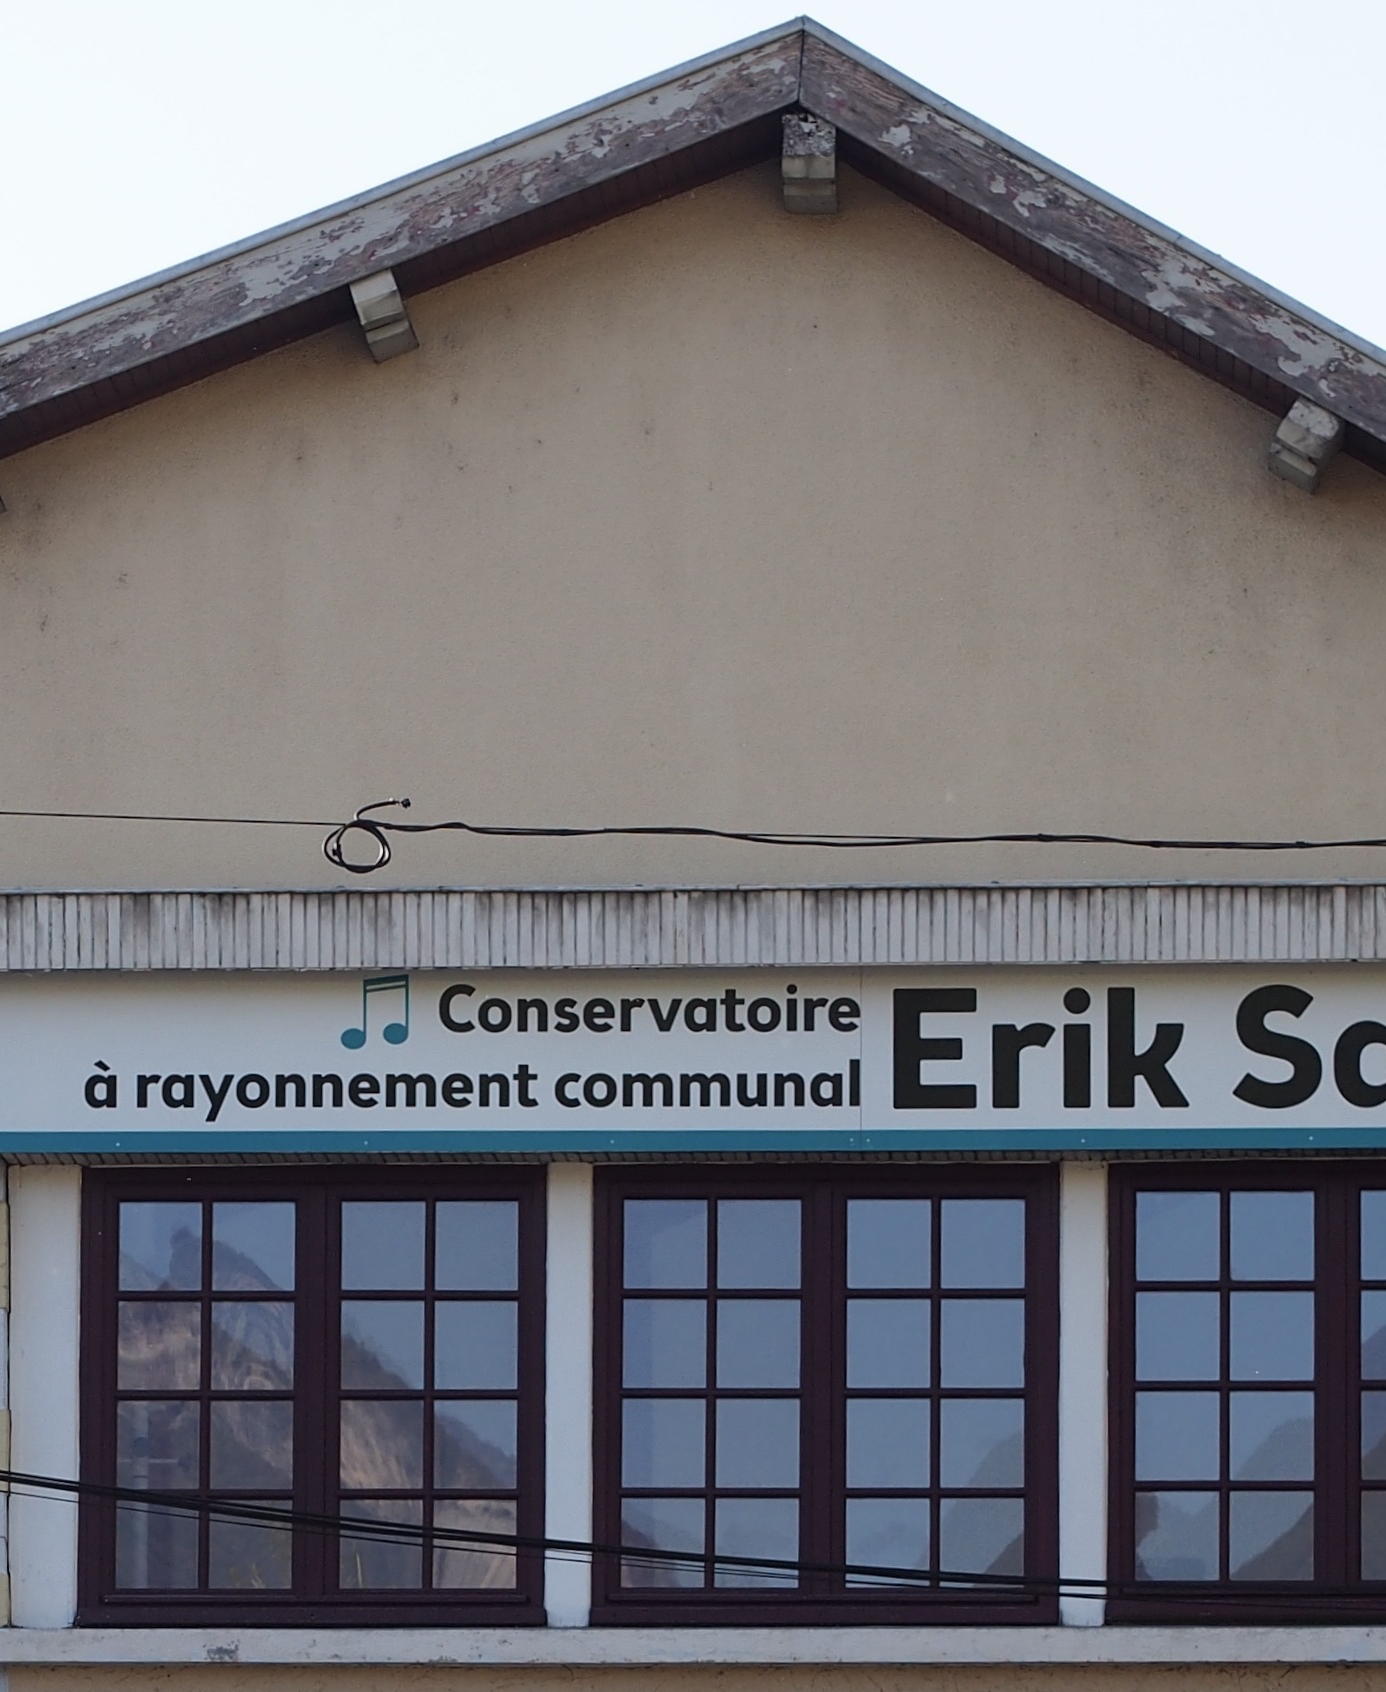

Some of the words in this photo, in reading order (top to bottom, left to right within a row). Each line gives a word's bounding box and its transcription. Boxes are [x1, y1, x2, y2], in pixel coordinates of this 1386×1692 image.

[438, 983, 861, 1033] Conservatoire
[892, 986, 1190, 1109] Erik
[84, 1060, 118, 1109] à
[136, 1064, 539, 1123] rayonnement
[554, 1058, 861, 1108] communal
